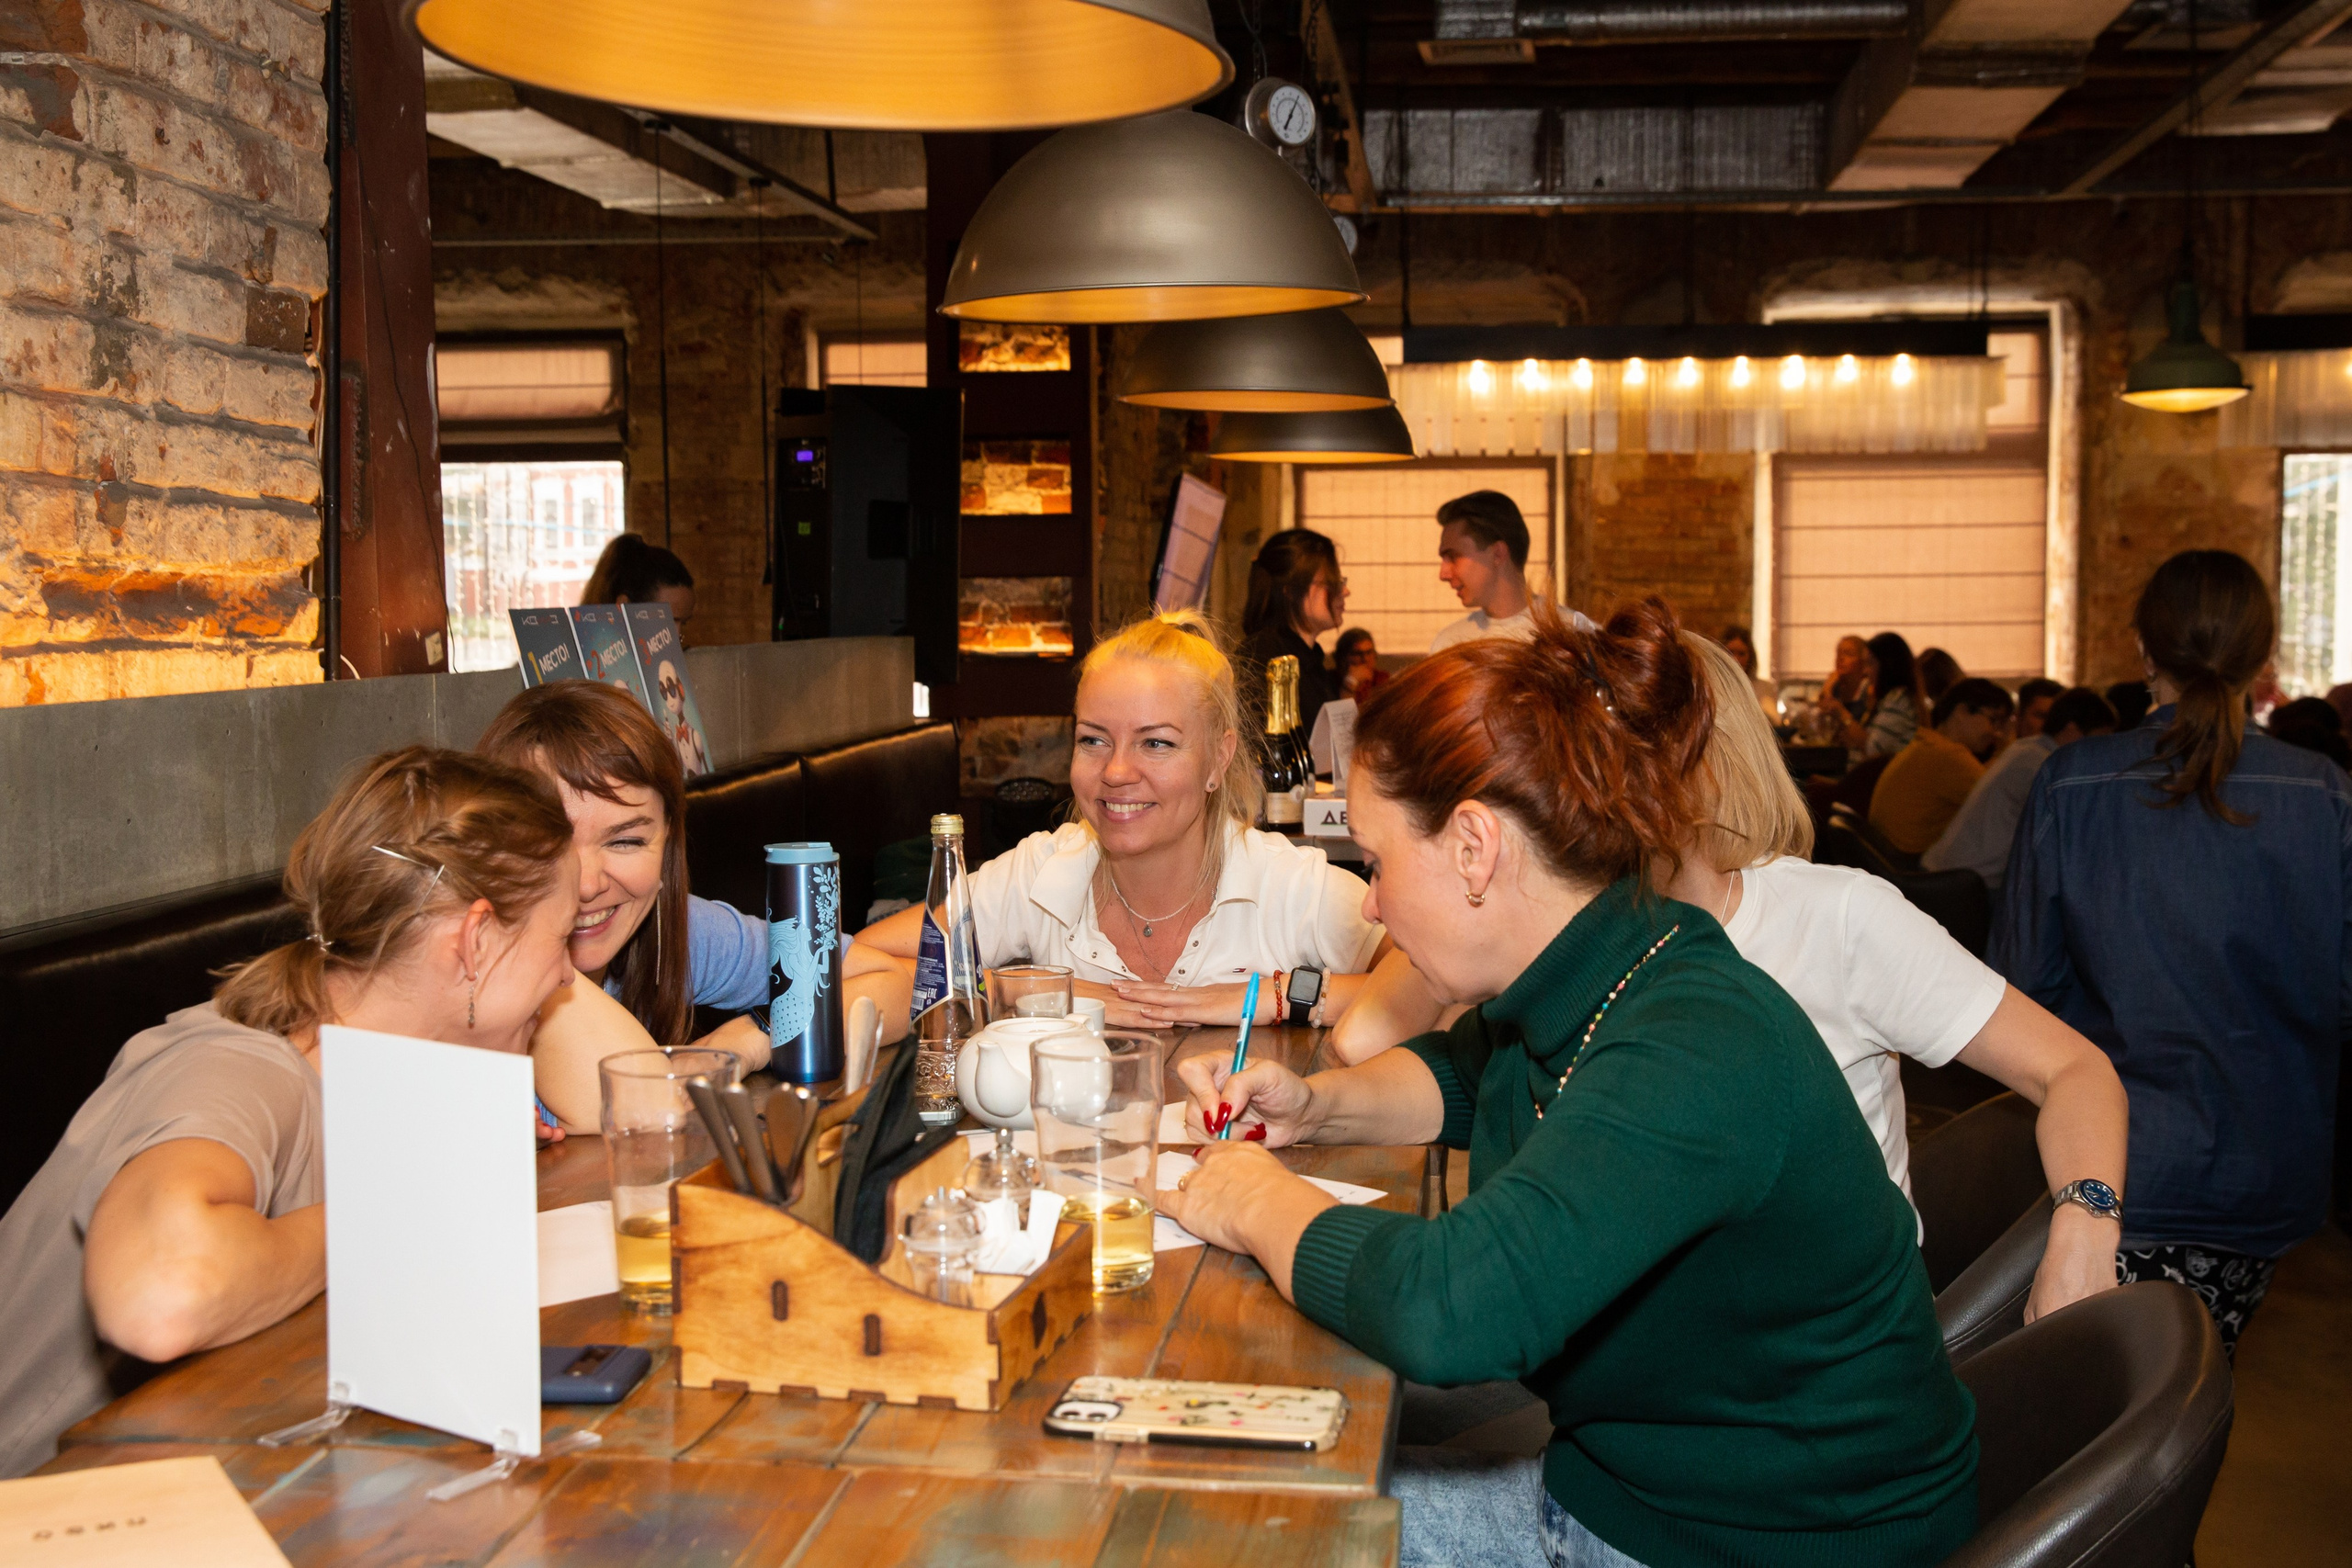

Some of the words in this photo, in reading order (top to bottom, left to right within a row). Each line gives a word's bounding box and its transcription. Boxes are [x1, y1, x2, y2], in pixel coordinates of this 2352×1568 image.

[527, 651, 543, 684] 1
[538, 642, 571, 675] МЕСТО!
[592, 649, 606, 680] 2
[600, 638, 628, 668] МЕСТО!
[638, 637, 651, 665] 3
[647, 626, 673, 656] МЕСТО!
